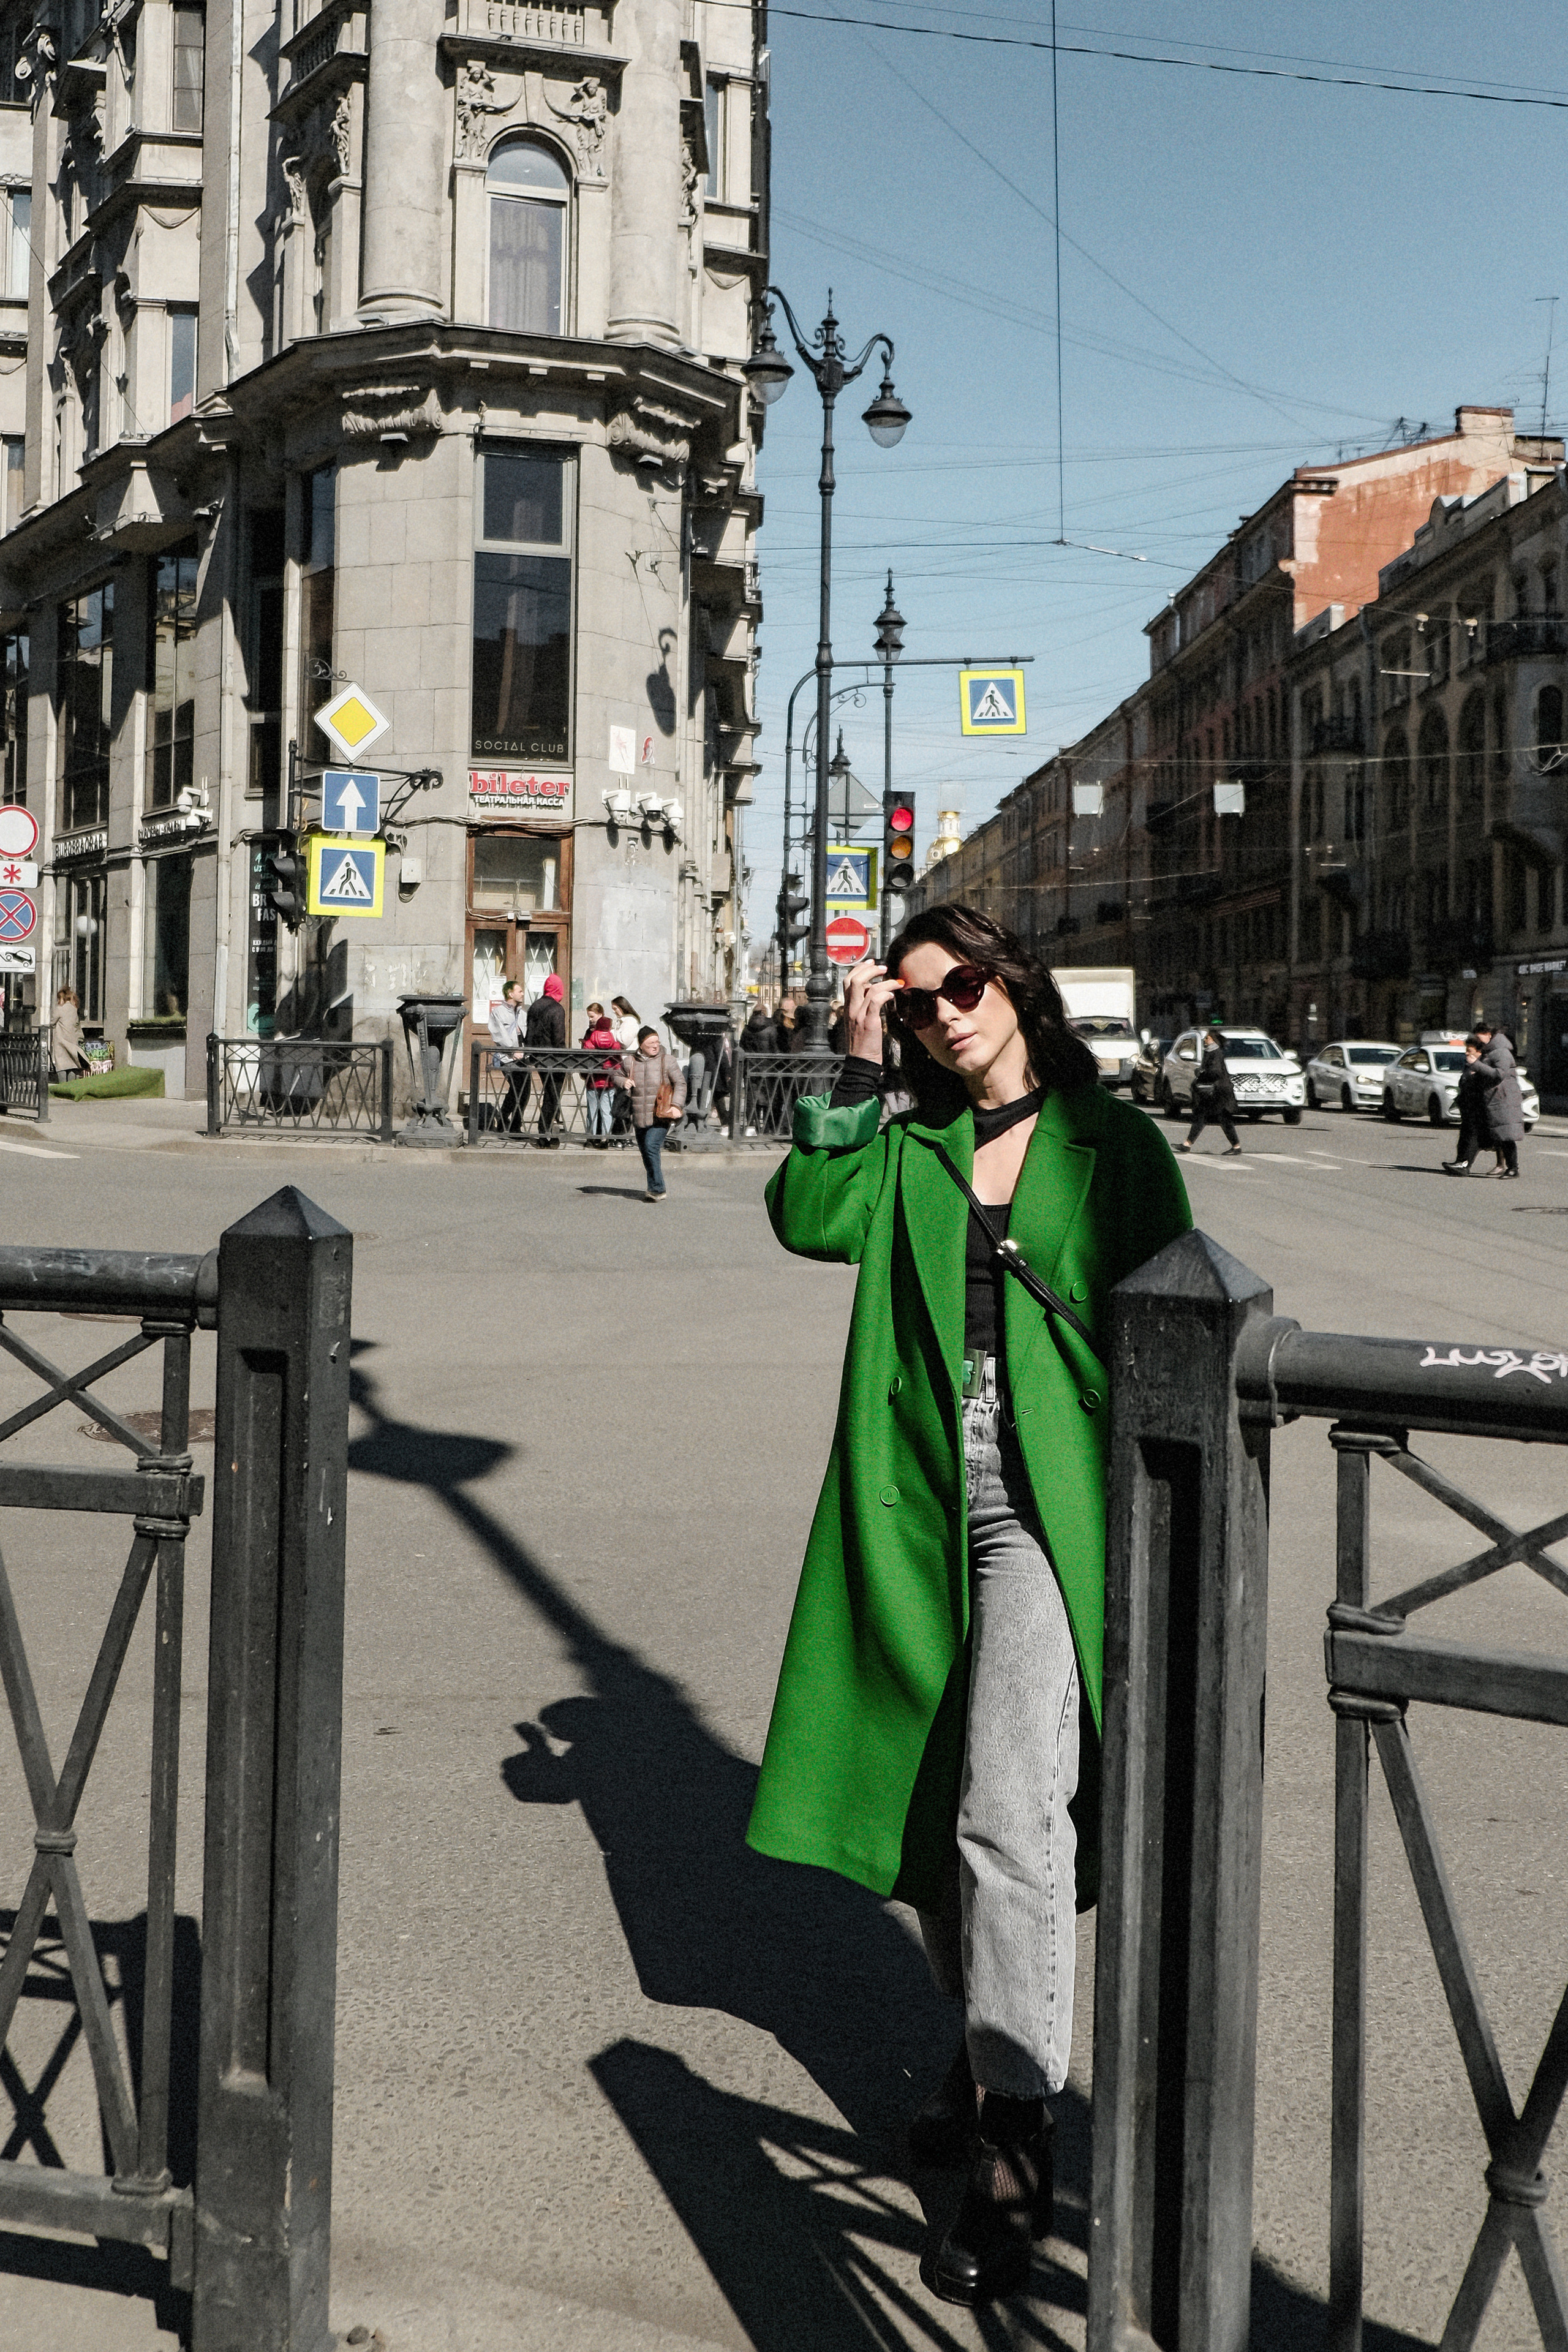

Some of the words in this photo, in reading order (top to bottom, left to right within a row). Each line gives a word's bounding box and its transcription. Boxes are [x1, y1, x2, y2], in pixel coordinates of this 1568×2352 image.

[475, 740, 526, 751] SOCIAL
[531, 744, 564, 753] CLUB
[470, 772, 570, 796] bileter
[473, 794, 535, 805] ТЕАТРАЛЬНАЯ
[536, 798, 565, 807] КАССА
